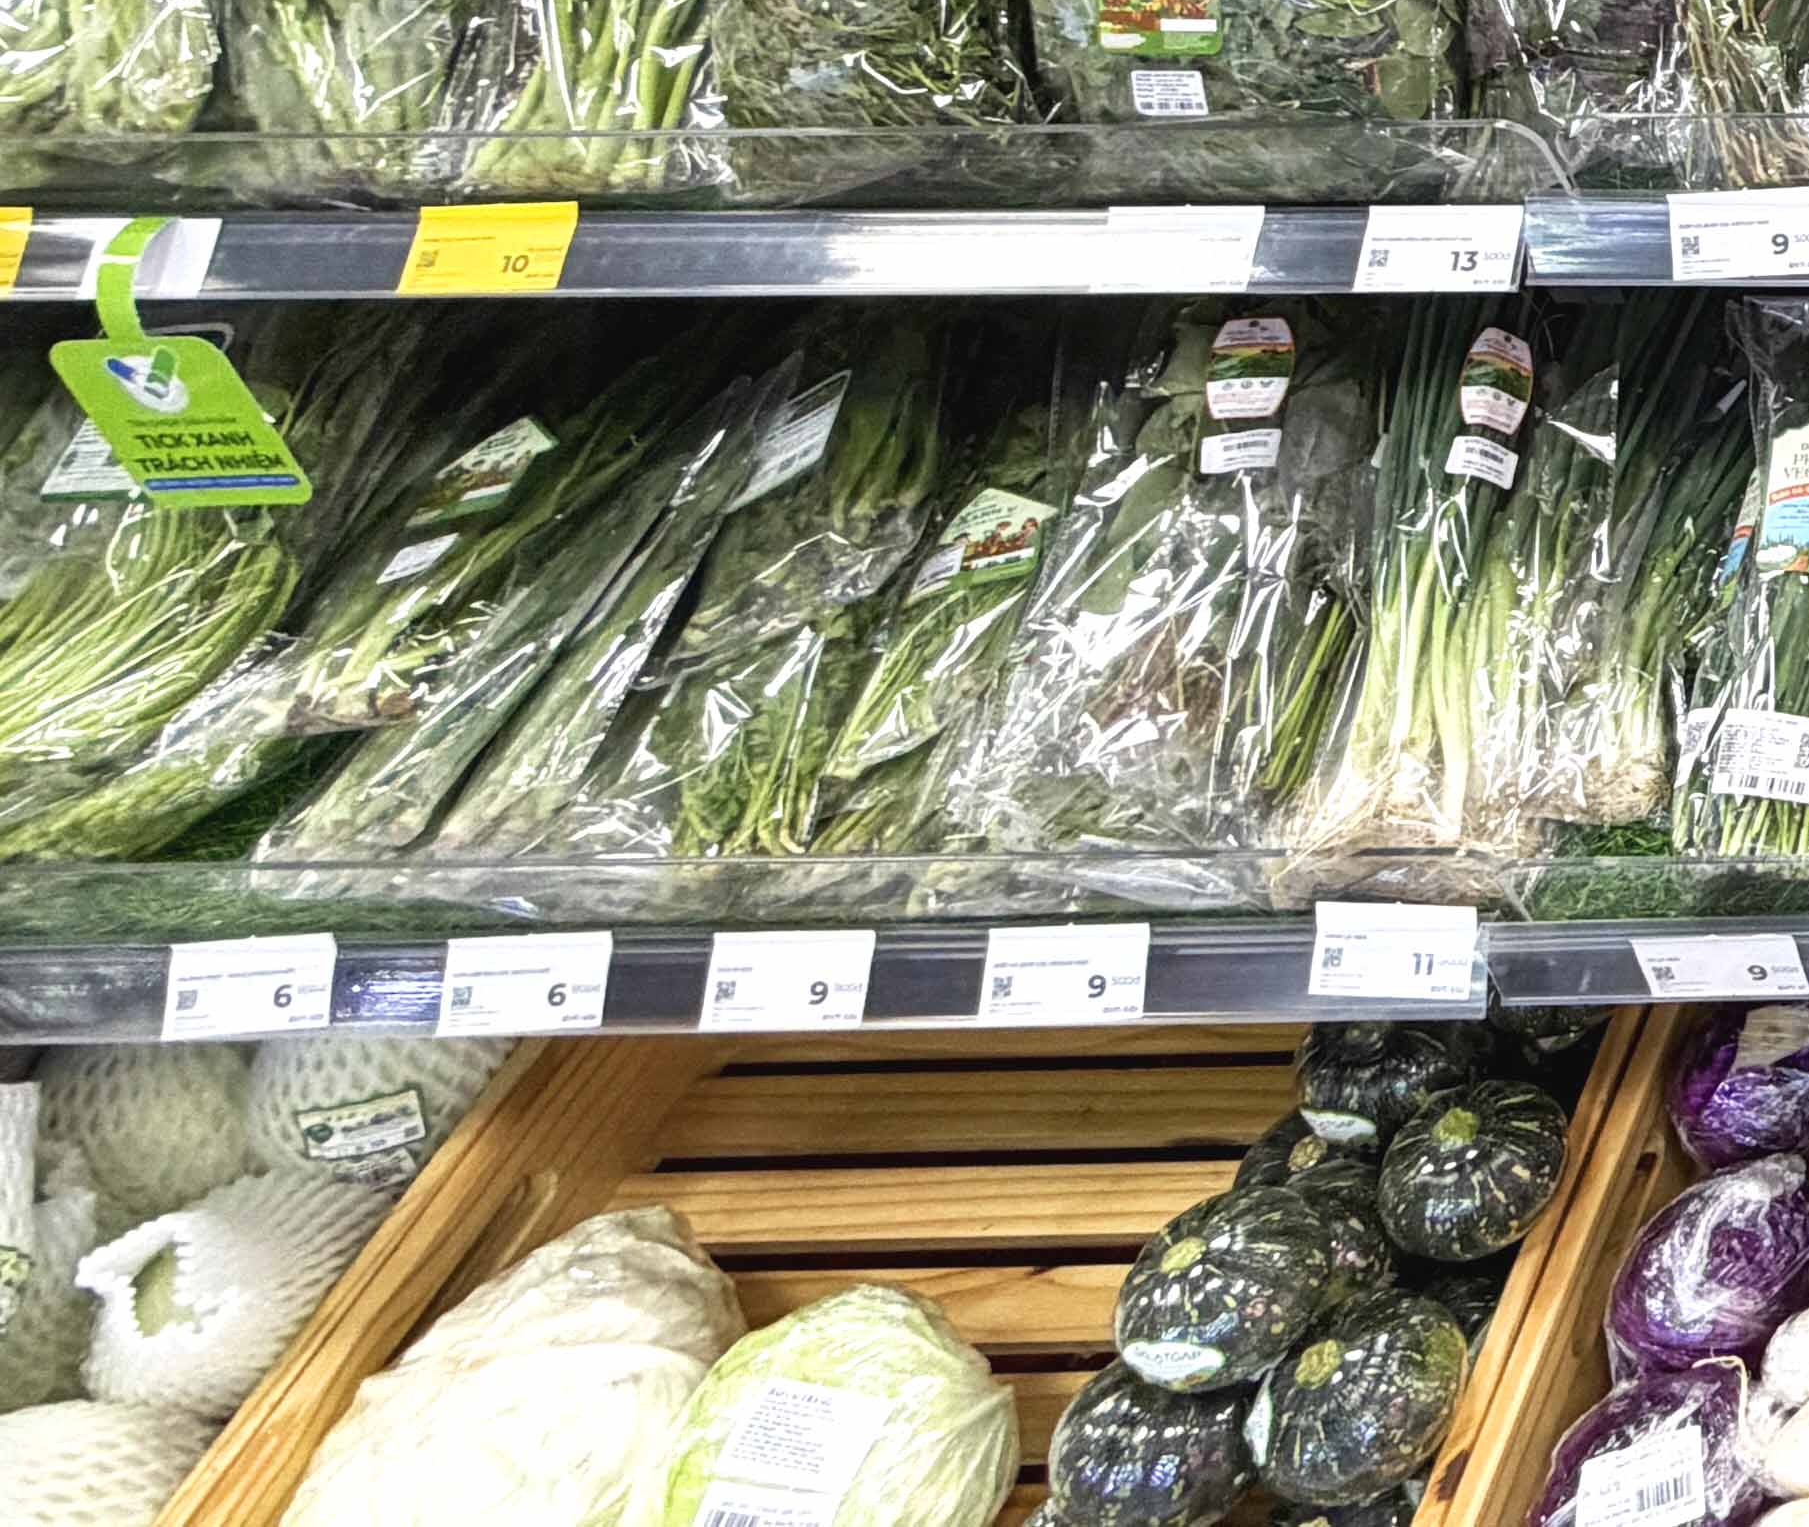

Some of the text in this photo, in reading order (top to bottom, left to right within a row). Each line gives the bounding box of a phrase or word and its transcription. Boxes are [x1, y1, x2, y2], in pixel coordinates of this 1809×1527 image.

[1771, 233, 1790, 255] 9
[500, 255, 531, 275] 10
[1450, 250, 1479, 272] 13
[133, 431, 256, 449] TICK XANH
[133, 449, 287, 472] TRÁCH NHIỆM
[1412, 952, 1434, 976] 11
[1746, 964, 1769, 981] 9
[273, 984, 293, 1009] 6
[547, 982, 567, 1007] 6
[808, 980, 829, 1006] 9
[1087, 974, 1107, 999] 9
